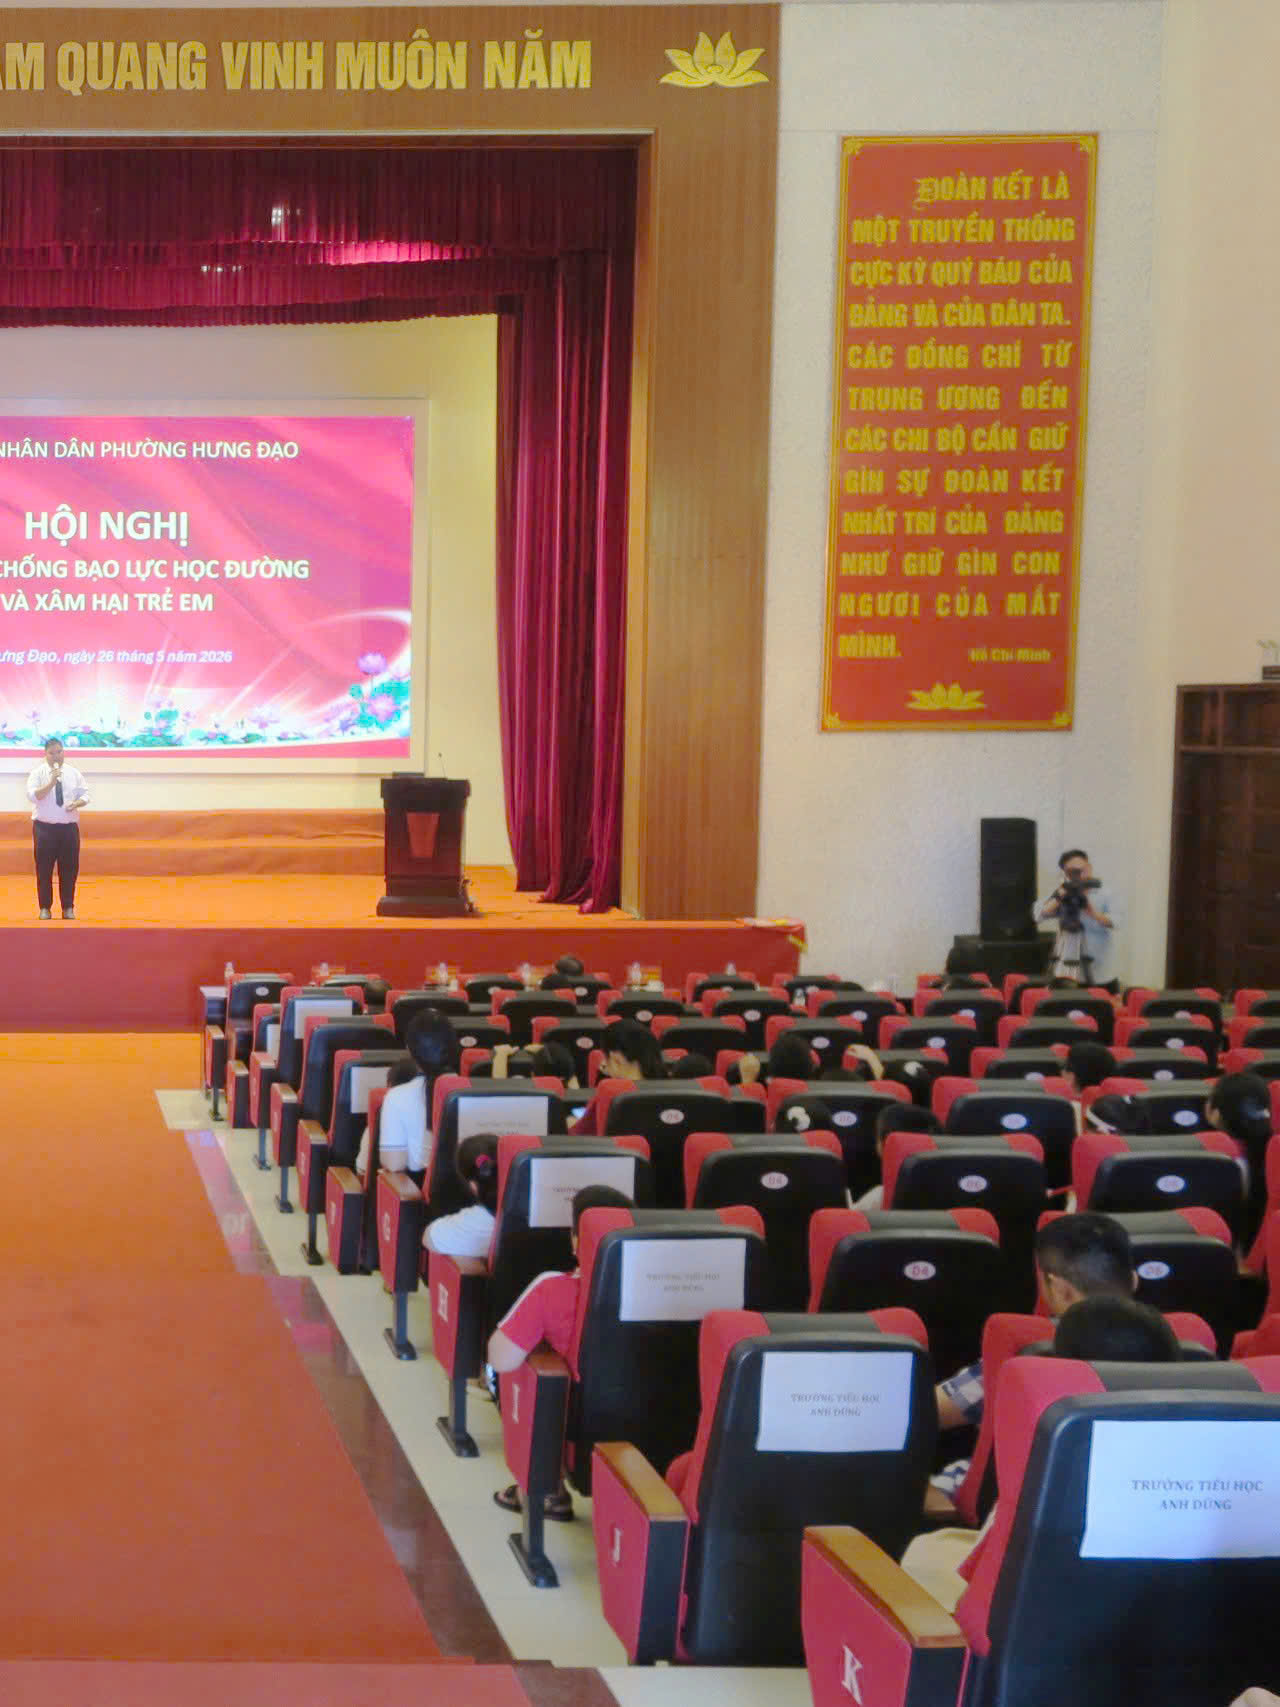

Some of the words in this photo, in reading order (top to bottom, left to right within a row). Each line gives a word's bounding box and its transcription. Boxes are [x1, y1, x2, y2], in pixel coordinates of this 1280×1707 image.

[56, 40, 207, 96] QUANG
[220, 41, 324, 90] VINH
[336, 27, 468, 90] MUÔN
[483, 27, 592, 90] NĂM
[1041, 171, 1070, 200] LÀ
[54, 438, 94, 457] DÂN
[101, 437, 186, 457] PHƯỜNG
[192, 441, 251, 458] HƯNG
[256, 441, 299, 461] ĐẠO
[25, 503, 88, 547] HỘI
[100, 511, 188, 547] NGHỊ
[75, 559, 120, 582] BẠO
[126, 559, 167, 582] LỰC
[173, 559, 219, 582] HỌC
[224, 555, 309, 579] ĐƯỜNG
[0, 589, 29, 611] VÀ
[35, 589, 85, 611] XÂM
[92, 593, 128, 615] HẠI
[135, 587, 173, 611] TRẺ
[180, 593, 213, 611] EM
[27, 649, 60, 664] Đạo,
[64, 652, 96, 664] ngày
[117, 650, 154, 664] tháng
[167, 651, 197, 663] năm
[200, 651, 233, 663] 2026
[1161, 1499, 1189, 1510] ANH
[841, 1644, 863, 1707] K
